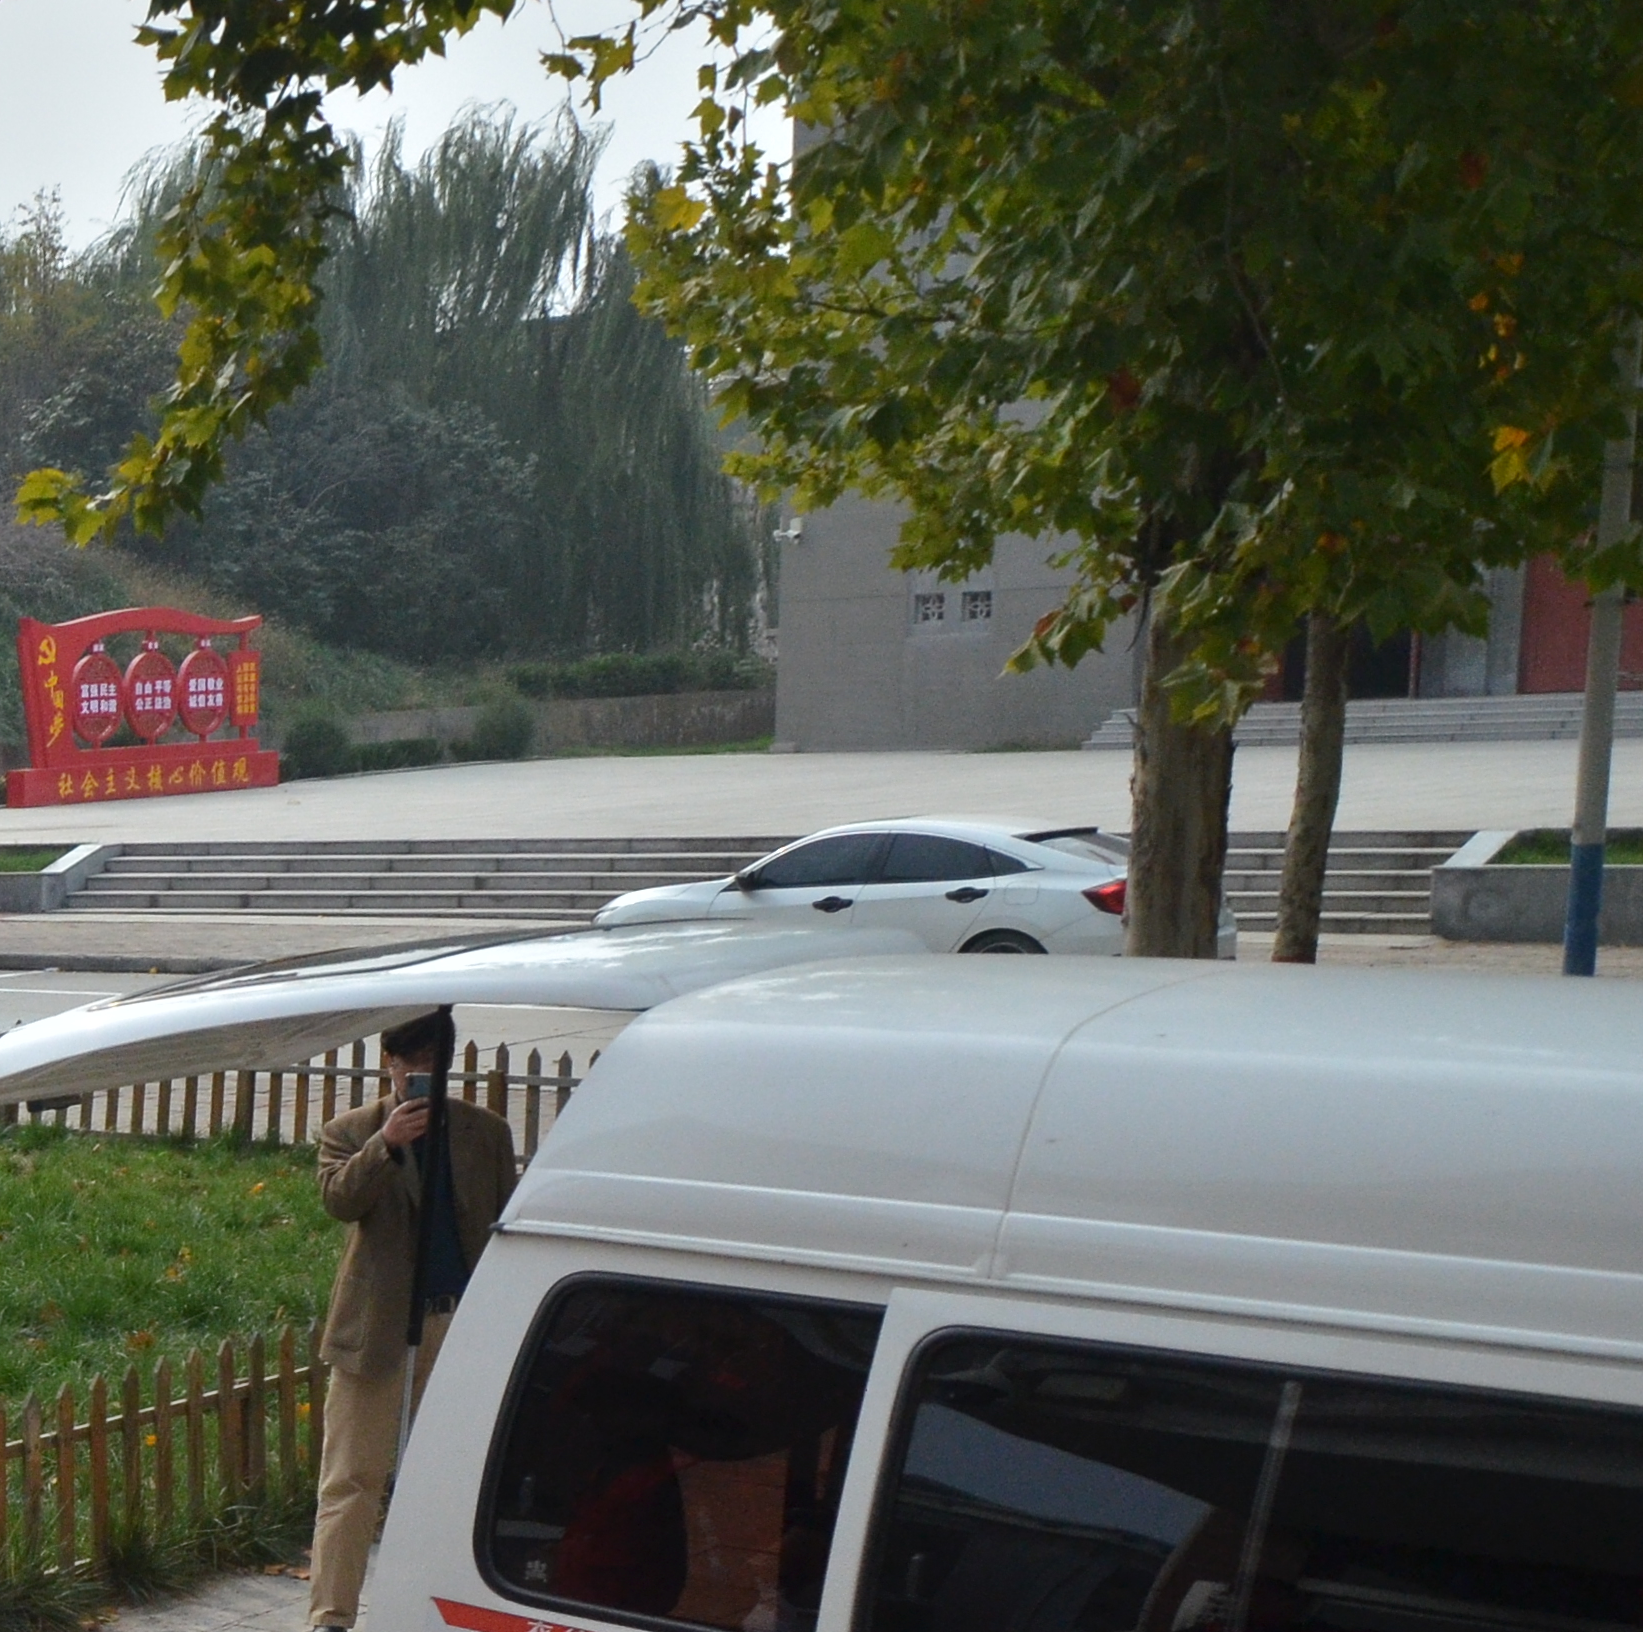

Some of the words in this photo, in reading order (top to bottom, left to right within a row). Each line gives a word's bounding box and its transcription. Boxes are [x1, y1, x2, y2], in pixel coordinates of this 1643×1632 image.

[58, 757, 250, 798] 社会主义核心价值观
